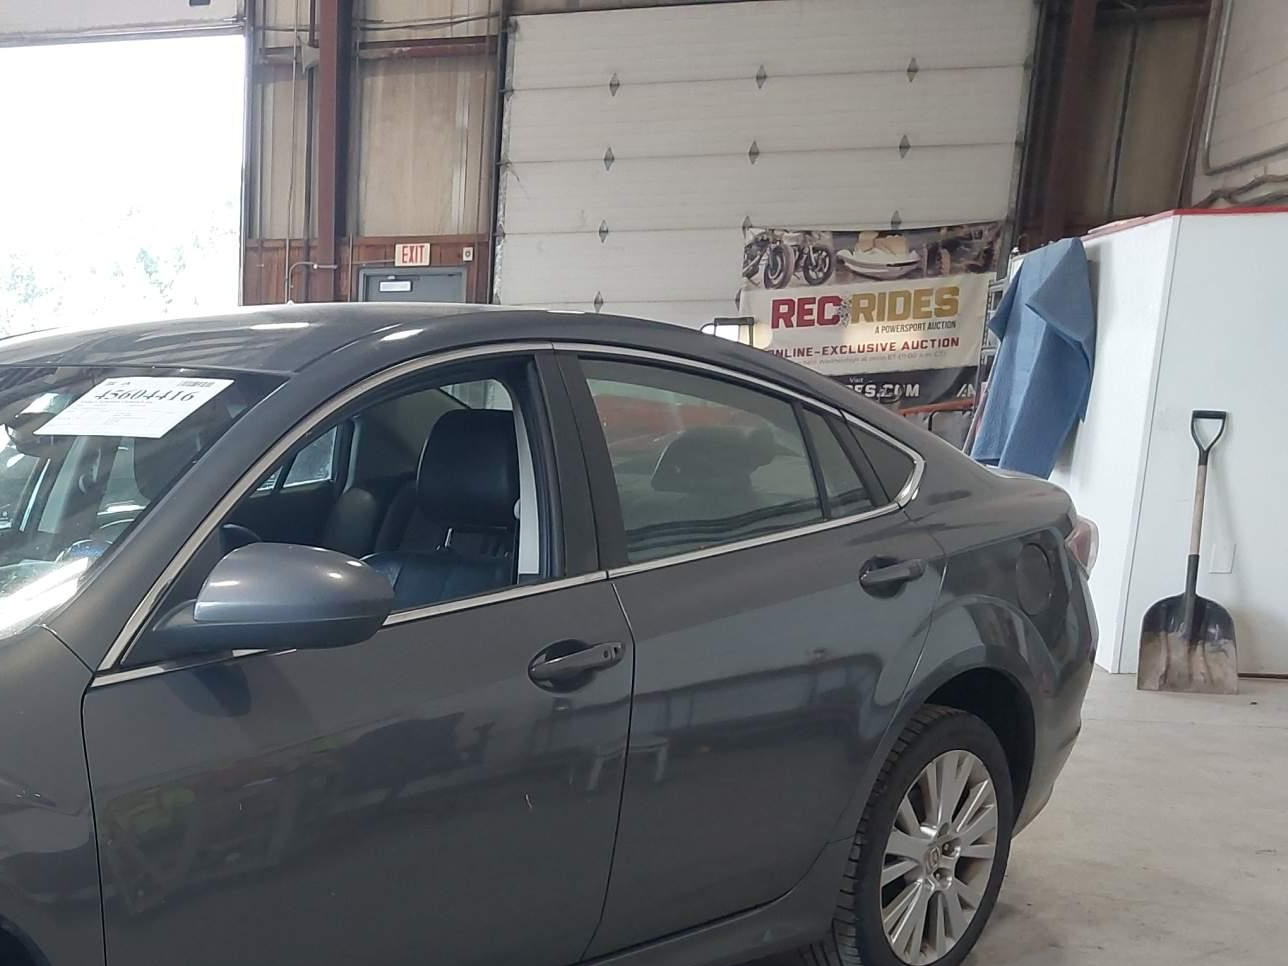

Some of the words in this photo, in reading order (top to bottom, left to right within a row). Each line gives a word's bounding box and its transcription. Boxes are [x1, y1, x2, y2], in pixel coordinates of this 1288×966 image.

[401, 245, 425, 264] EXIT
[771, 295, 842, 329] REC
[849, 286, 960, 324] RIDES
[874, 326, 880, 334] A
[881, 323, 927, 334] POWERSPORT
[927, 320, 957, 331] AUCTION
[770, 341, 897, 359] NLINE-EXCLUSIVE
[900, 337, 960, 351] AUCTION
[95, 388, 200, 402] 45604416
